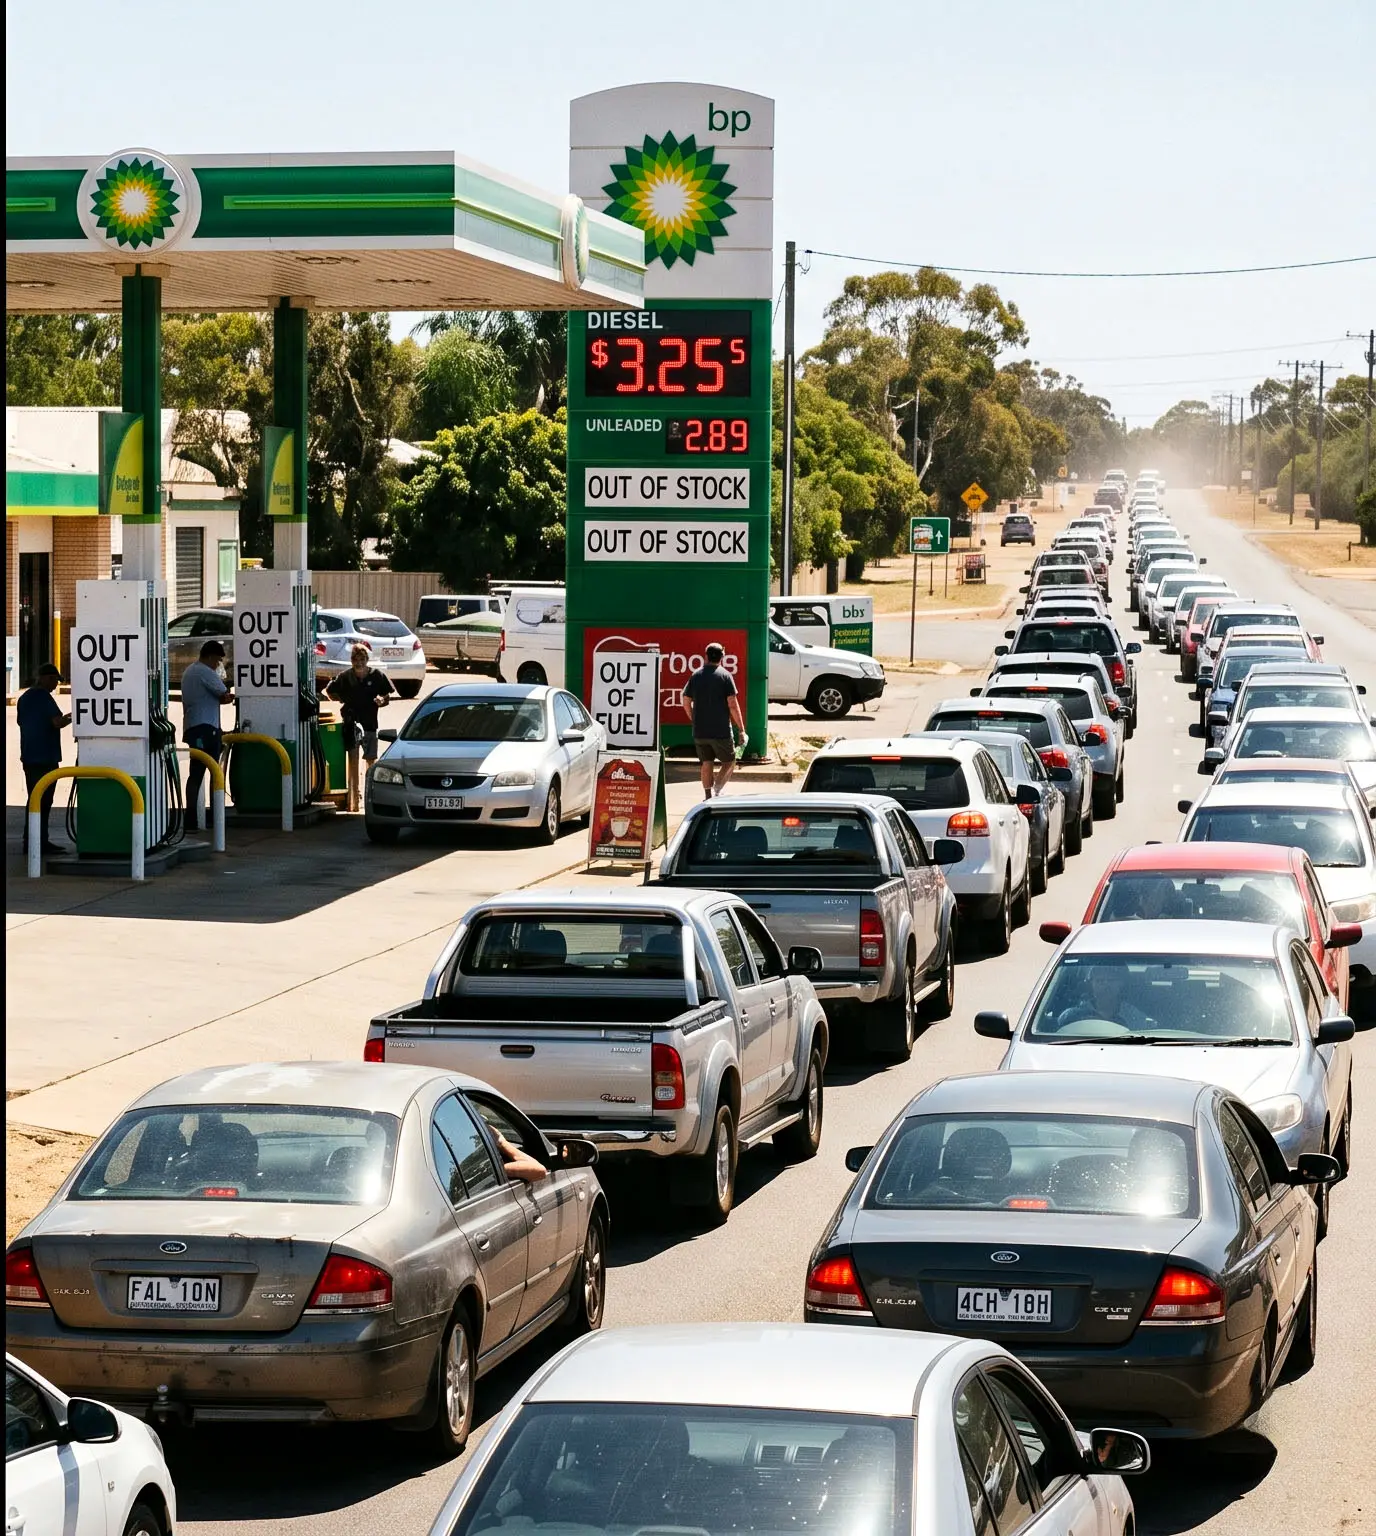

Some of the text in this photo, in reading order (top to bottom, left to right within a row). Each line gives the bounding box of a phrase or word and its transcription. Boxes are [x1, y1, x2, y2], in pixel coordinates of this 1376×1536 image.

[708, 103, 752, 138] bp
[587, 311, 664, 330] DIESEL
[586, 418, 748, 453] UNLEADED 2.89
[589, 476, 747, 501] OUT OF STOCK
[588, 530, 746, 555] OUT OF STOCK
[238, 611, 290, 635] OUT
[77, 634, 139, 663] OUT
[249, 639, 279, 659] OF
[89, 668, 124, 692] OF
[237, 664, 293, 688] FUEL
[600, 661, 648, 684] OUT
[608, 688, 636, 707] OF
[76, 698, 143, 727] FUEL
[596, 712, 648, 736] FUEL
[131, 1280, 167, 1302] FAL
[960, 1291, 998, 1314] 4CH
